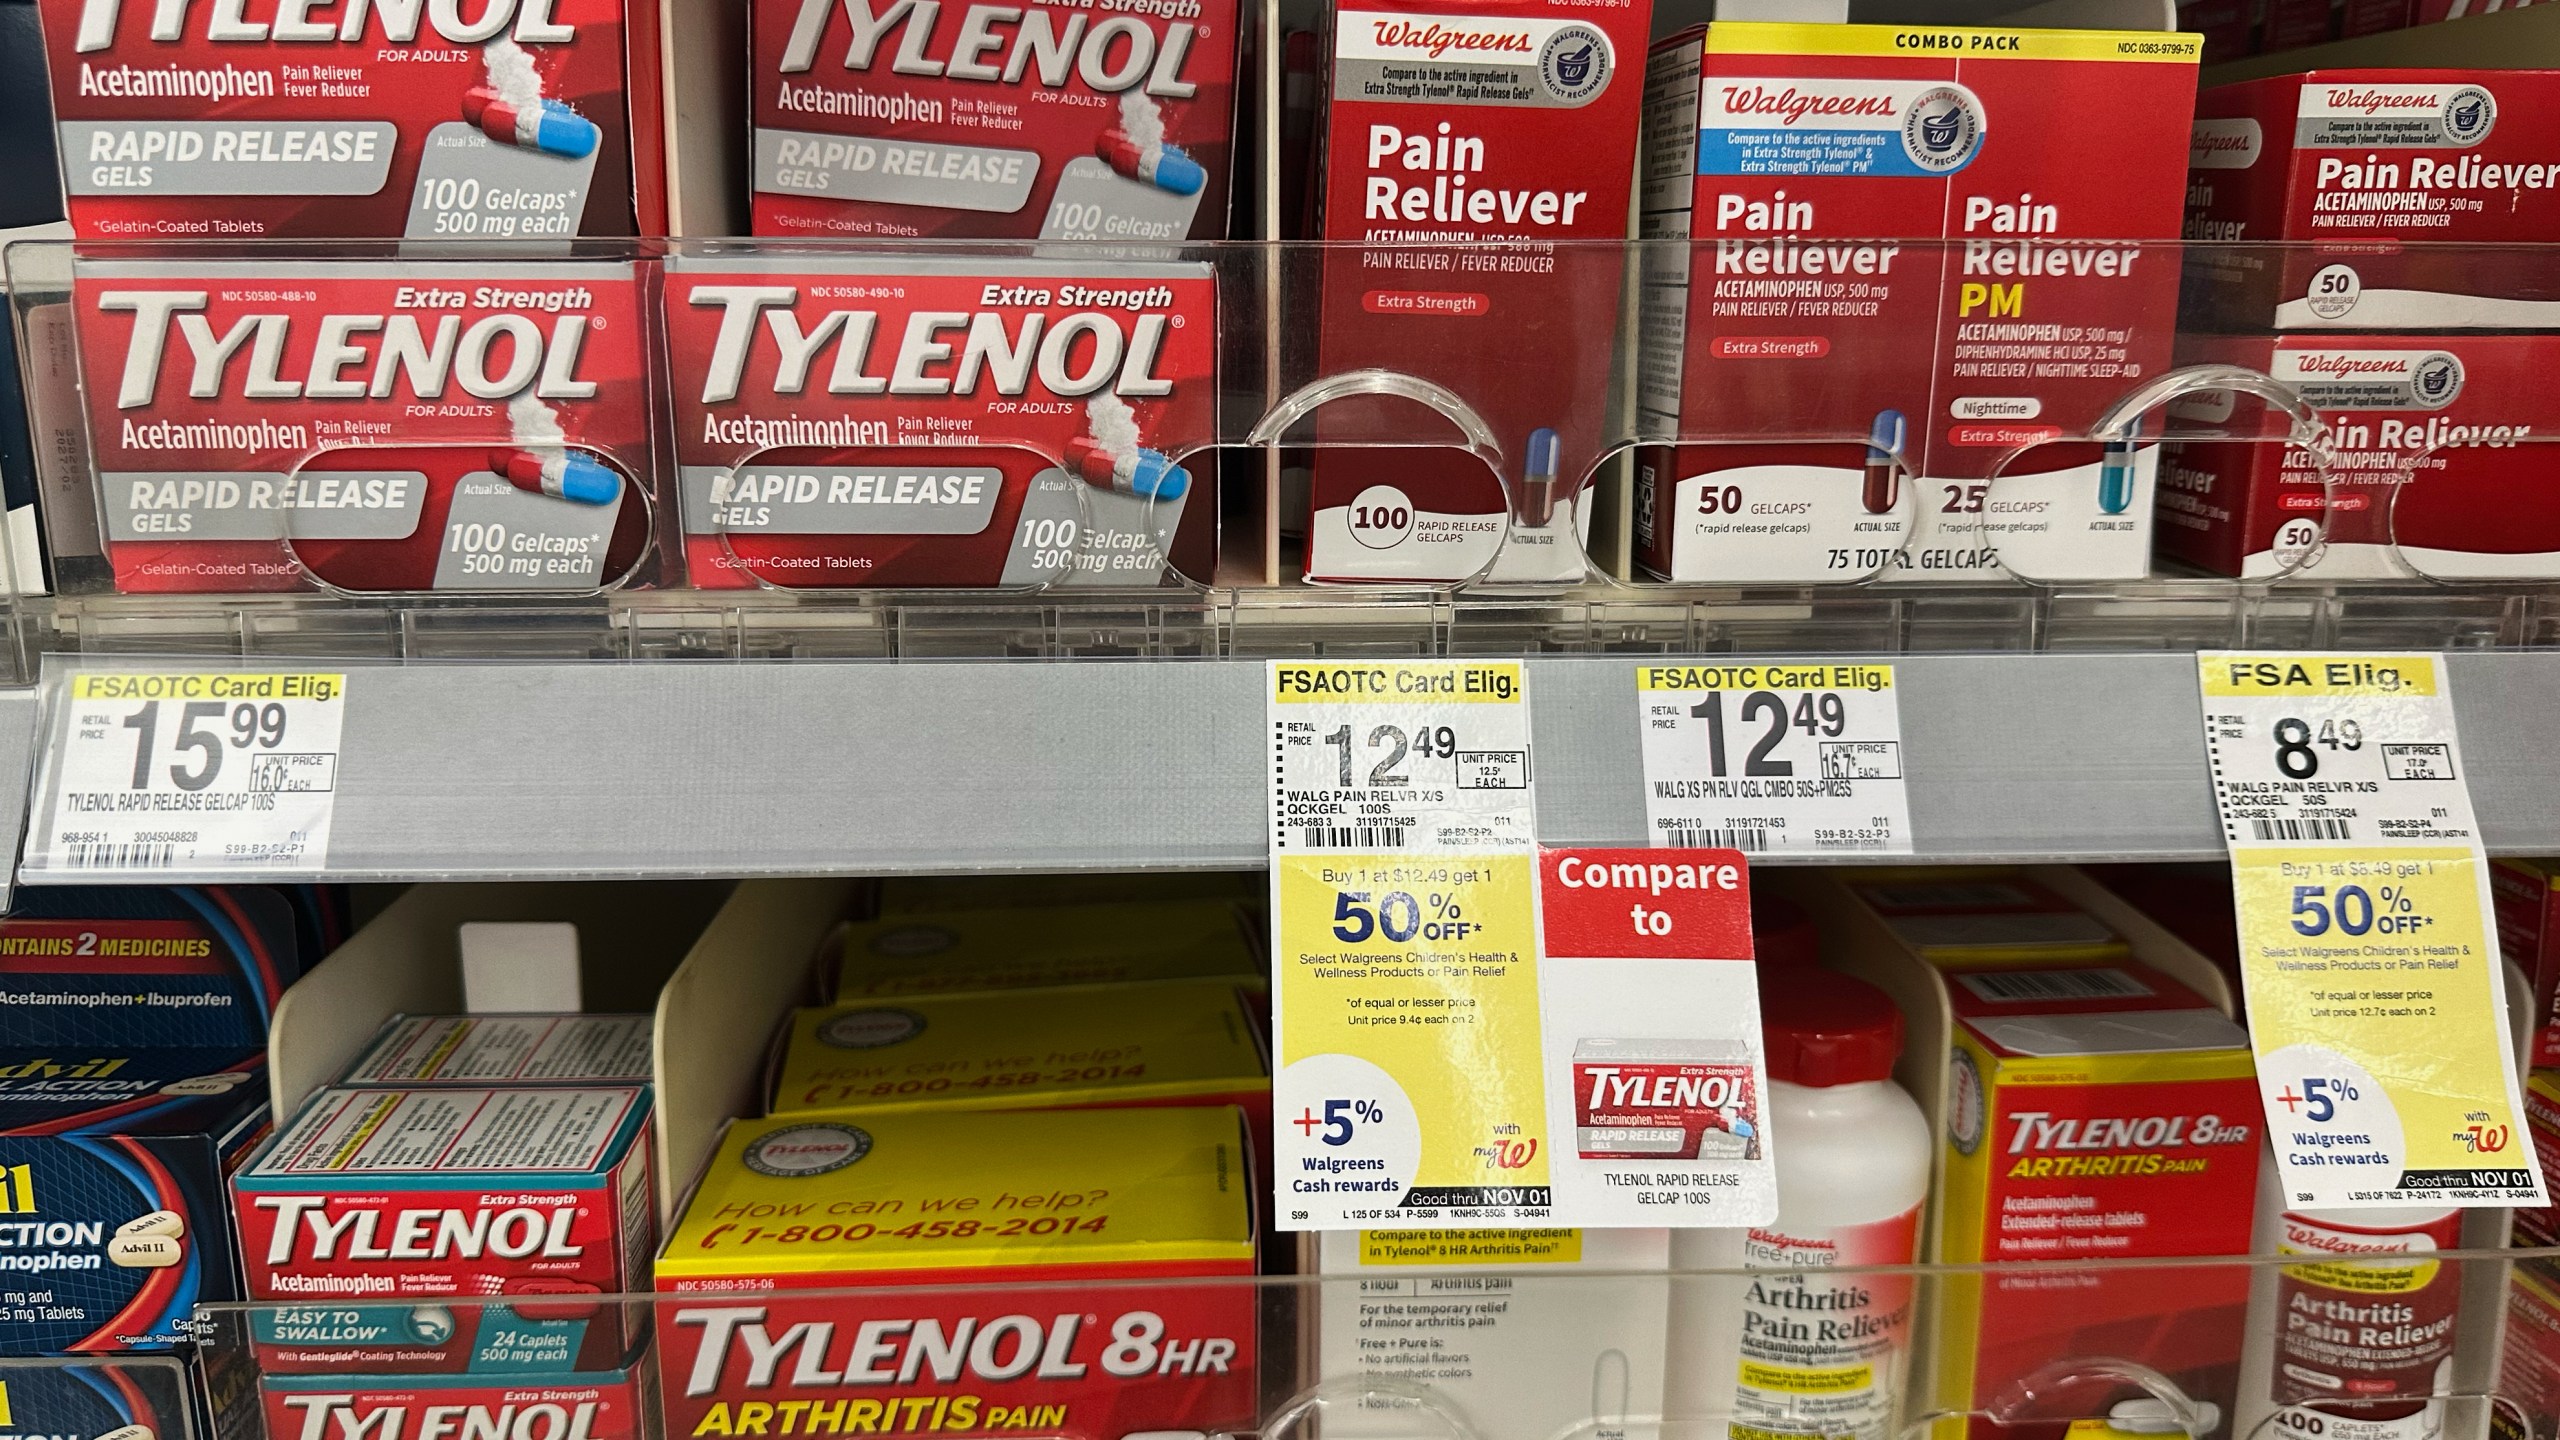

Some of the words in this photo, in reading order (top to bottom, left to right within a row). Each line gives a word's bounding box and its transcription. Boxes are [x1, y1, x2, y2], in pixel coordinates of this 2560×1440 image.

[1373, 21, 1533, 59] Walgreens
[1896, 34, 1966, 50] COMBO
[1971, 35, 2020, 51] PACK
[2117, 42, 2137, 55] NDC
[2138, 42, 2195, 56] 0363-9799-75
[80, 63, 274, 101] Acetaminophen
[283, 65, 310, 80] Pain
[313, 65, 363, 80] Reliever
[1382, 66, 1417, 82] Compare
[1418, 67, 1427, 81] to
[1428, 67, 1442, 81] the
[1443, 68, 1467, 83] active
[1468, 69, 1508, 86] ingredient
[1510, 71, 1518, 84] in
[284, 82, 318, 97] Fever
[321, 82, 371, 97] Reducer
[778, 81, 942, 125] Acetaminophen
[1722, 86, 1896, 126] Walgreens
[2327, 90, 2439, 116] Walgreens
[90, 131, 203, 162] RAPID
[212, 131, 378, 162] RELEASE
[1368, 122, 1485, 172] Pain
[92, 166, 153, 187] GELS
[2316, 154, 2400, 190] Pain
[2409, 154, 2560, 190] Reliever
[422, 179, 480, 210] 100
[1365, 174, 1588, 226] Reliever
[1716, 191, 1813, 231] Pain
[1965, 194, 2057, 233] Pain
[213, 220, 264, 233] Tablets
[434, 212, 479, 234] 500
[481, 216, 513, 236] mg
[521, 212, 570, 234] each
[2321, 274, 2350, 294] 50
[394, 288, 467, 309] Extra
[472, 287, 592, 313] Strength
[980, 286, 1052, 307] Extra
[1057, 286, 1173, 311] Strength
[1377, 294, 1414, 309] Extra
[1416, 295, 1477, 313] Strength
[1959, 284, 2024, 319] PM
[1723, 341, 1758, 355] Extra
[1761, 341, 1819, 357] Strength
[1964, 402, 2027, 416] Nighttime
[121, 419, 307, 455] Acetaminophen
[1699, 486, 1742, 514] 50
[1354, 506, 1408, 530] 100
[1417, 520, 1449, 531] RAPID
[1451, 521, 1498, 533] RELEASE
[1416, 532, 1464, 544] GELCAPS
[1279, 670, 1387, 693] FSAOTC
[1395, 670, 1455, 693] Card
[1465, 670, 1519, 698] Elig.
[1650, 668, 1757, 689] FSAOTC
[1766, 667, 1825, 688] Card
[1834, 667, 1889, 692] Elig.
[2230, 663, 2312, 686] FSA
[2325, 663, 2412, 691] Elig.
[87, 677, 202, 698] FSAOTC
[210, 677, 273, 697] Card
[282, 676, 339, 702] Elig.
[1287, 722, 1316, 732] RETAIL
[1288, 736, 1312, 745] PRICE
[1287, 791, 1330, 802] WALG
[1334, 791, 1367, 802] PAIN
[1371, 791, 1417, 802] RELVR
[1422, 791, 1444, 802] X/S
[1654, 780, 1685, 798] WALG
[1687, 780, 1700, 798] XS
[1703, 780, 1717, 798] PN
[1719, 780, 1738, 798] RLV
[1740, 780, 1762, 798] QGL
[1764, 780, 1794, 798] CMBO
[1797, 780, 1852, 798] 50S+PM25S
[68, 793, 115, 811] TYLENOL
[118, 793, 150, 811] RAPID
[153, 794, 202, 811] RELEASE
[205, 794, 249, 811] GELCAP
[251, 793, 275, 811] 100S
[1287, 803, 1347, 815] QCKGEL
[1359, 803, 1391, 815] 100S
[1558, 857, 1739, 896] Compare
[1631, 903, 1673, 936] to
[76, 932, 98, 956] 2
[100, 939, 211, 957] MEDICINES
[1299, 953, 1337, 965] Select
[1340, 952, 1402, 967] Walgreens
[1406, 951, 1466, 964] Children's
[1469, 952, 1507, 963] Health
[1510, 952, 1519, 963] &
[1314, 966, 1367, 978] Wellness
[1371, 966, 1424, 978] Products
[1427, 968, 1440, 977] or
[1444, 966, 1469, 977] Pain
[1473, 965, 1506, 977] Relief
[2292, 1132, 2371, 1148] Walgreens
[1302, 1157, 1385, 1173] Walgreens
[2007, 1154, 2163, 1179] ARTHRITIS
[2163, 1158, 2208, 1174] PAIN
[2289, 1152, 2326, 1166] Cash
[2329, 1152, 2390, 1165] rewards
[1293, 1178, 1332, 1192] Cash
[1334, 1177, 1399, 1193] rewards
[1604, 1173, 1654, 1186] TYLENOL
[1656, 1174, 1690, 1187] RAPID
[1692, 1173, 1740, 1186] RELEASE
[715, 1200, 816, 1220] How
[828, 1196, 904, 1215] can
[920, 1195, 981, 1213] we
[992, 1188, 1110, 1212] help?
[1411, 1192, 1449, 1206] Good
[1452, 1192, 1479, 1205] thru
[1483, 1188, 1524, 1205] NOV
[1529, 1188, 1549, 1205] 01
[1637, 1192, 1680, 1205] GELCAP
[1683, 1192, 1711, 1205] 100S
[741, 1214, 1110, 1246] 1-800-458-2014
[271, 1272, 396, 1295] Acetaminophen
[677, 1281, 698, 1292] NDC
[1745, 1280, 1870, 1312] Arthritis
[1360, 1303, 1381, 1315] For
[1383, 1303, 1404, 1315] the
[1406, 1304, 1472, 1317] temporary
[1474, 1301, 1508, 1314] relief
[2290, 1291, 2413, 1325] Arthritis
[1360, 1315, 1373, 1327] of
[1375, 1316, 1412, 1328] minor
[1415, 1314, 1466, 1328] arthritis
[1468, 1315, 1496, 1329] pain
[2287, 1311, 2350, 1345] Pain
[2358, 1314, 2454, 1347] Reliever
[493, 1331, 515, 1347] 24
[518, 1333, 568, 1349] Caplets
[693, 1396, 982, 1438] ARTHRITIS
[985, 1404, 1067, 1430] PAIN
